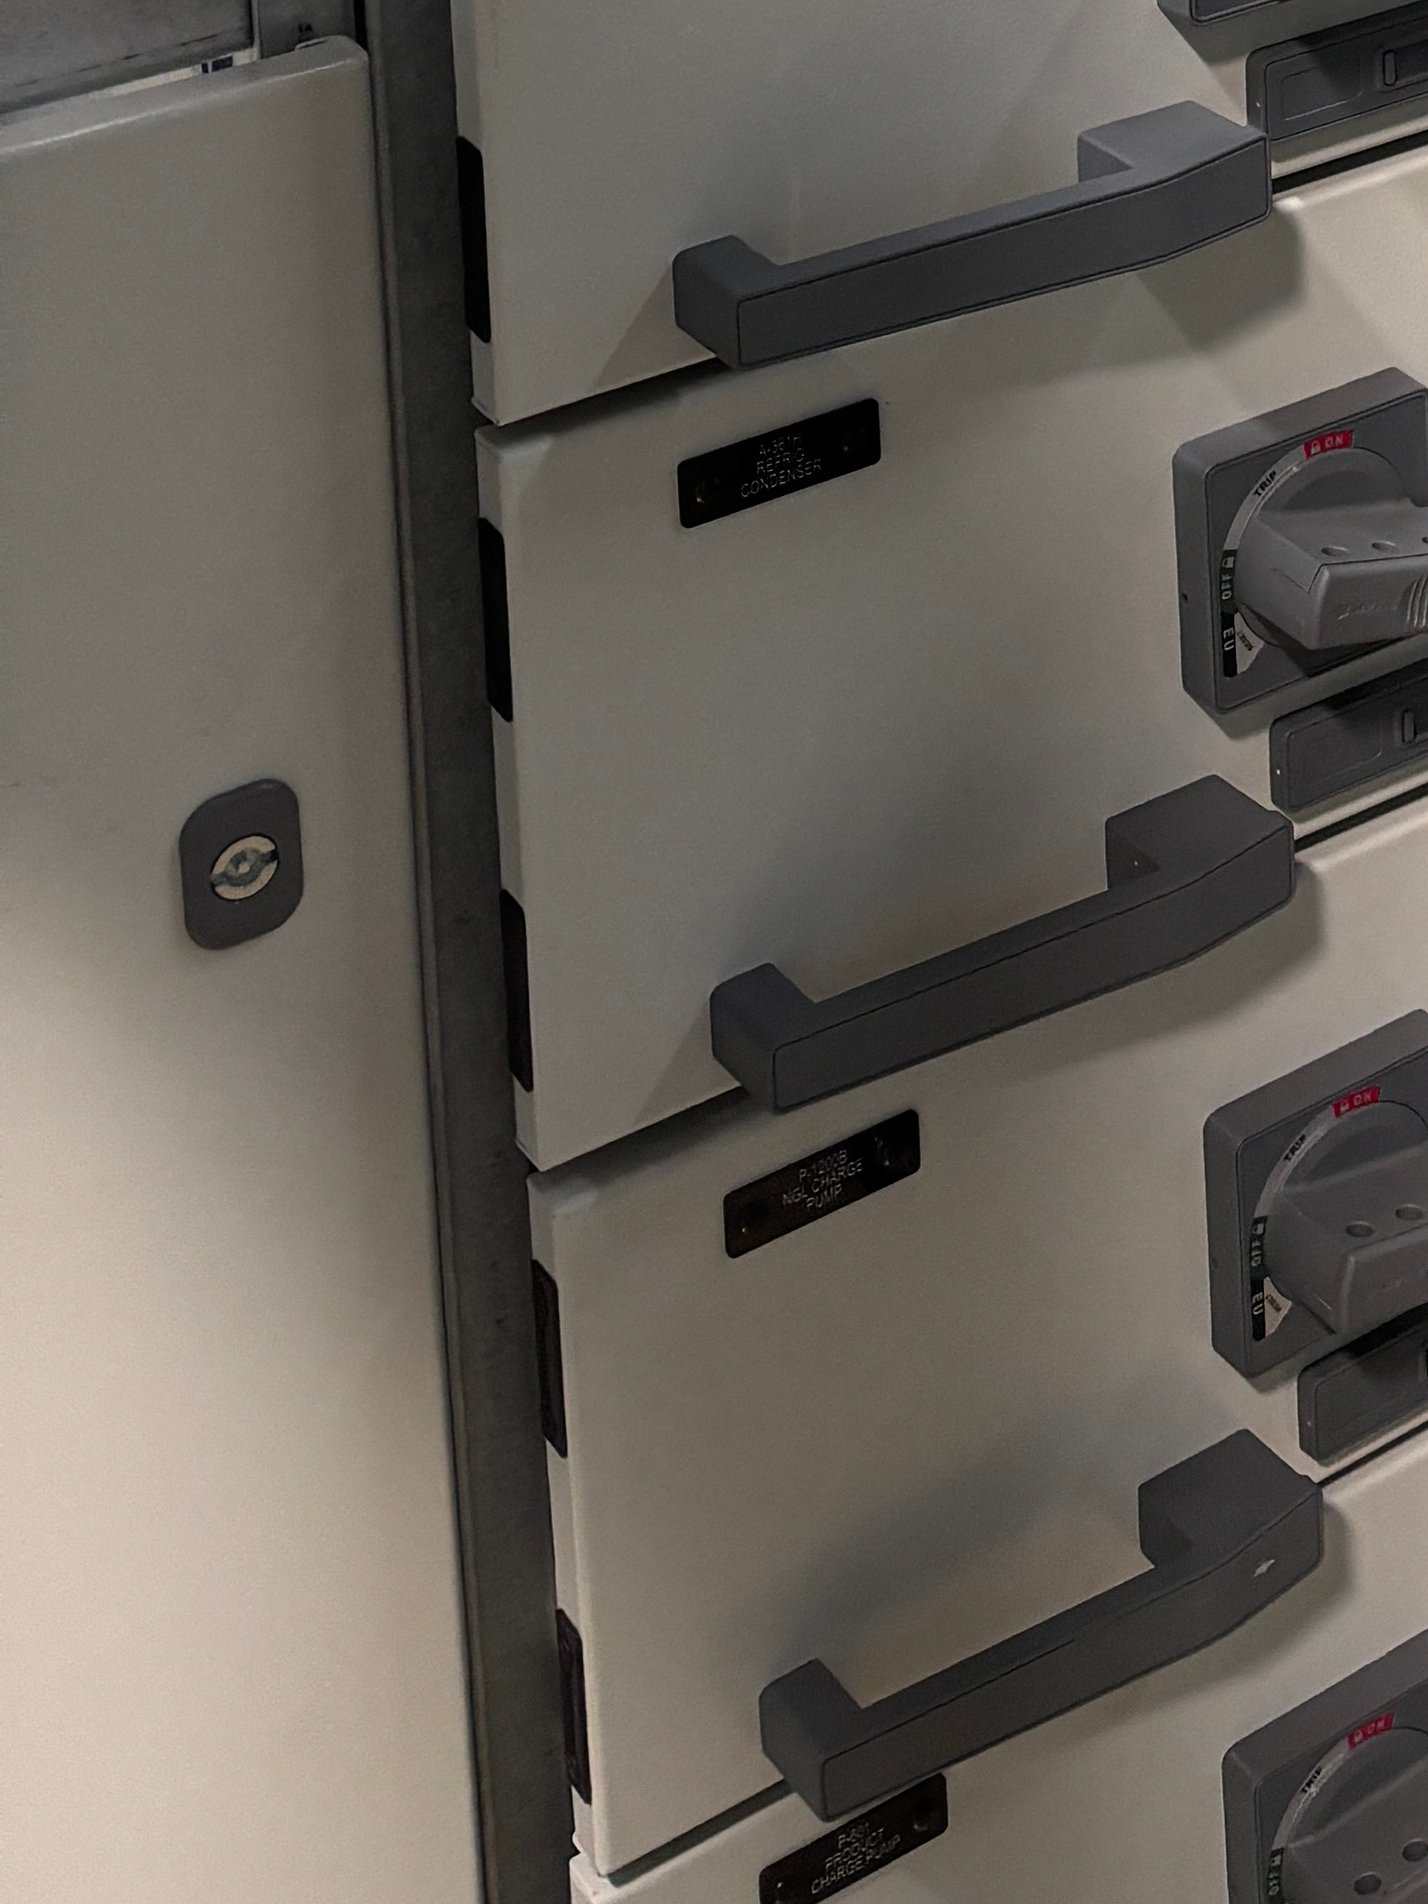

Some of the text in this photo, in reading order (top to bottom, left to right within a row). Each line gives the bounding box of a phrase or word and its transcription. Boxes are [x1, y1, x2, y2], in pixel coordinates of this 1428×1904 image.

[1325, 433, 1344, 449] ON
[741, 459, 822, 498] CONDENSER
[1253, 471, 1277, 498] TRIP
[1353, 1089, 1372, 1106] ON
[812, 1158, 864, 1194] CHARGE
